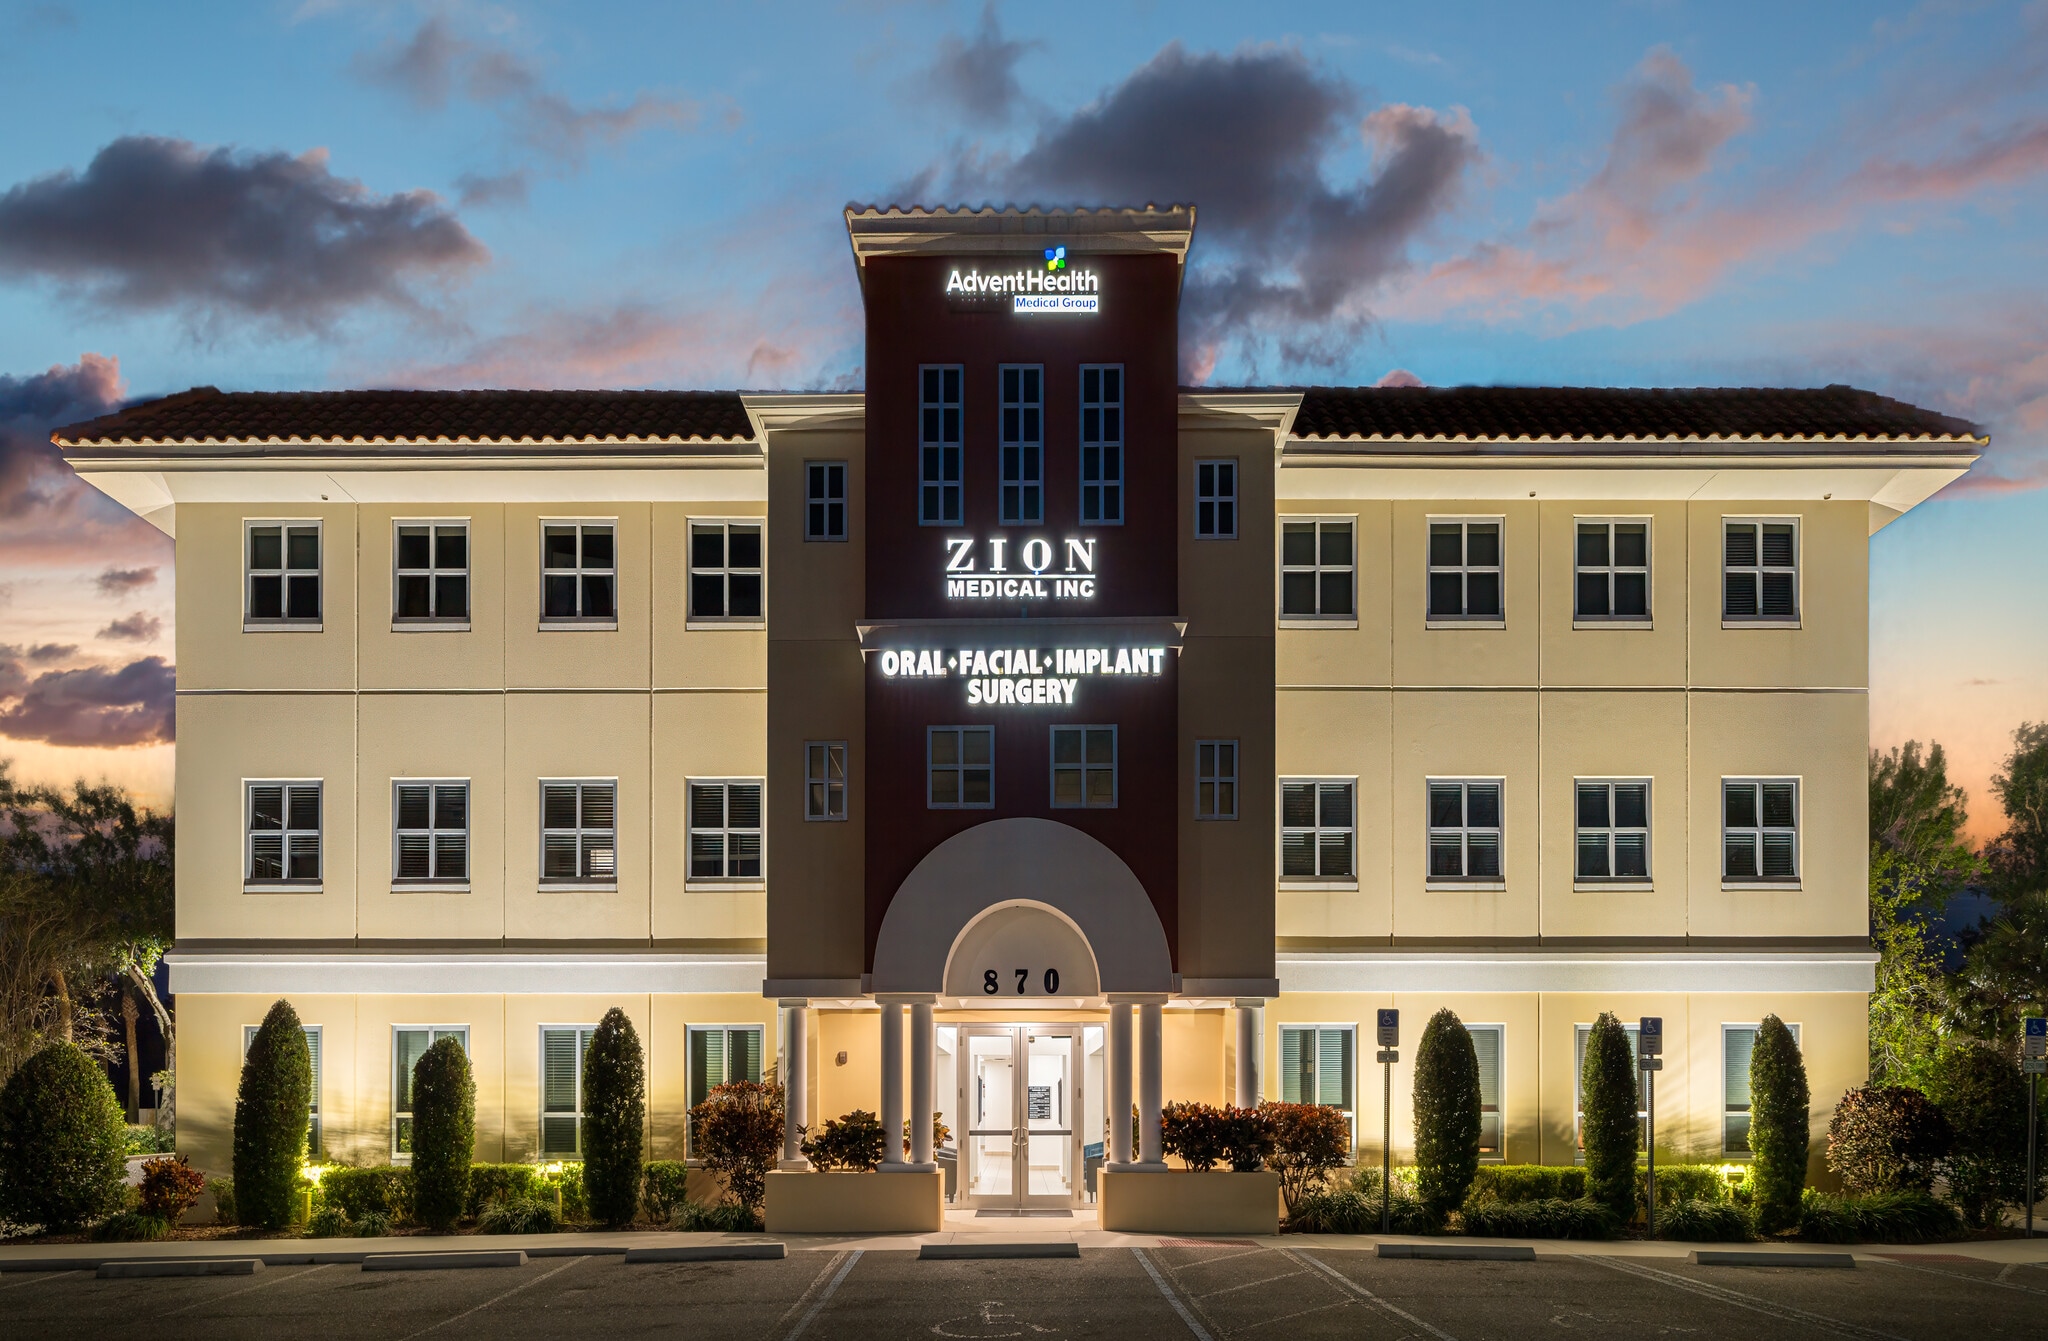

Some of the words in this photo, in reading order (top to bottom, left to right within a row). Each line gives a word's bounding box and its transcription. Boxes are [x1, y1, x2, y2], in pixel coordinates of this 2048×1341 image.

[946, 269, 1099, 292] AdventHealth
[1015, 297, 1059, 309] Medical
[1062, 297, 1097, 310] Group
[946, 538, 1097, 572] ZION
[947, 580, 1048, 598] MEDICAL
[1055, 580, 1095, 598] INC
[967, 678, 1078, 705] SURGERY
[983, 968, 1060, 995] 870
